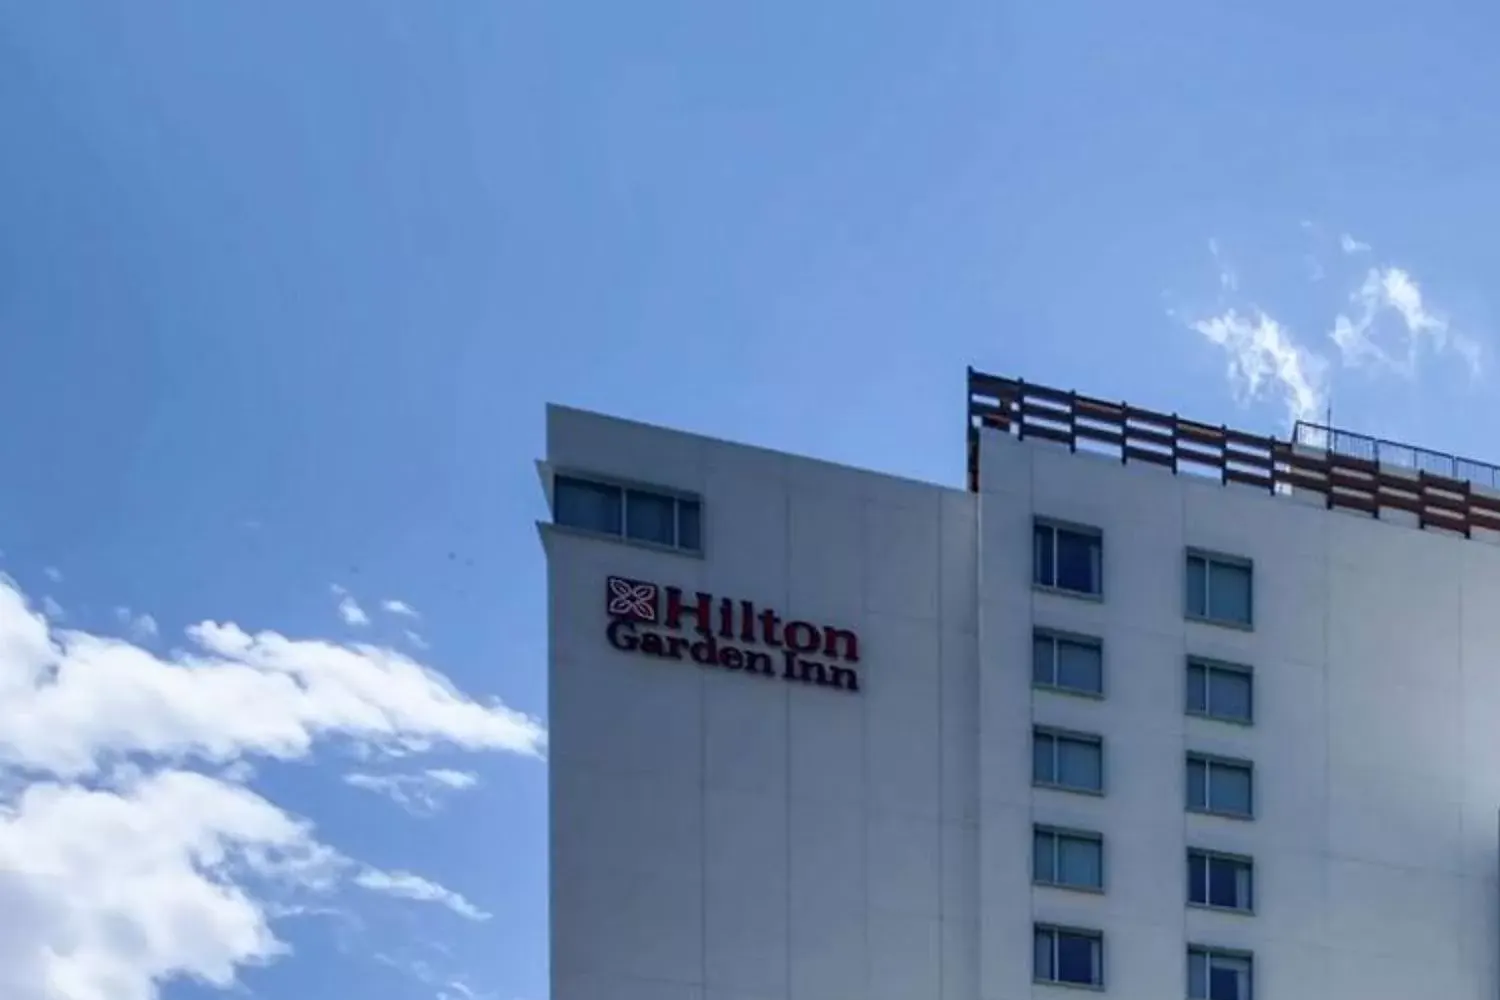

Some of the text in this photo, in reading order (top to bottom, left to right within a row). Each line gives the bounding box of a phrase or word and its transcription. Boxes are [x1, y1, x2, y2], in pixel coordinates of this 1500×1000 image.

[606, 620, 859, 692] Garden Inn
[664, 586, 859, 661] Hilton
